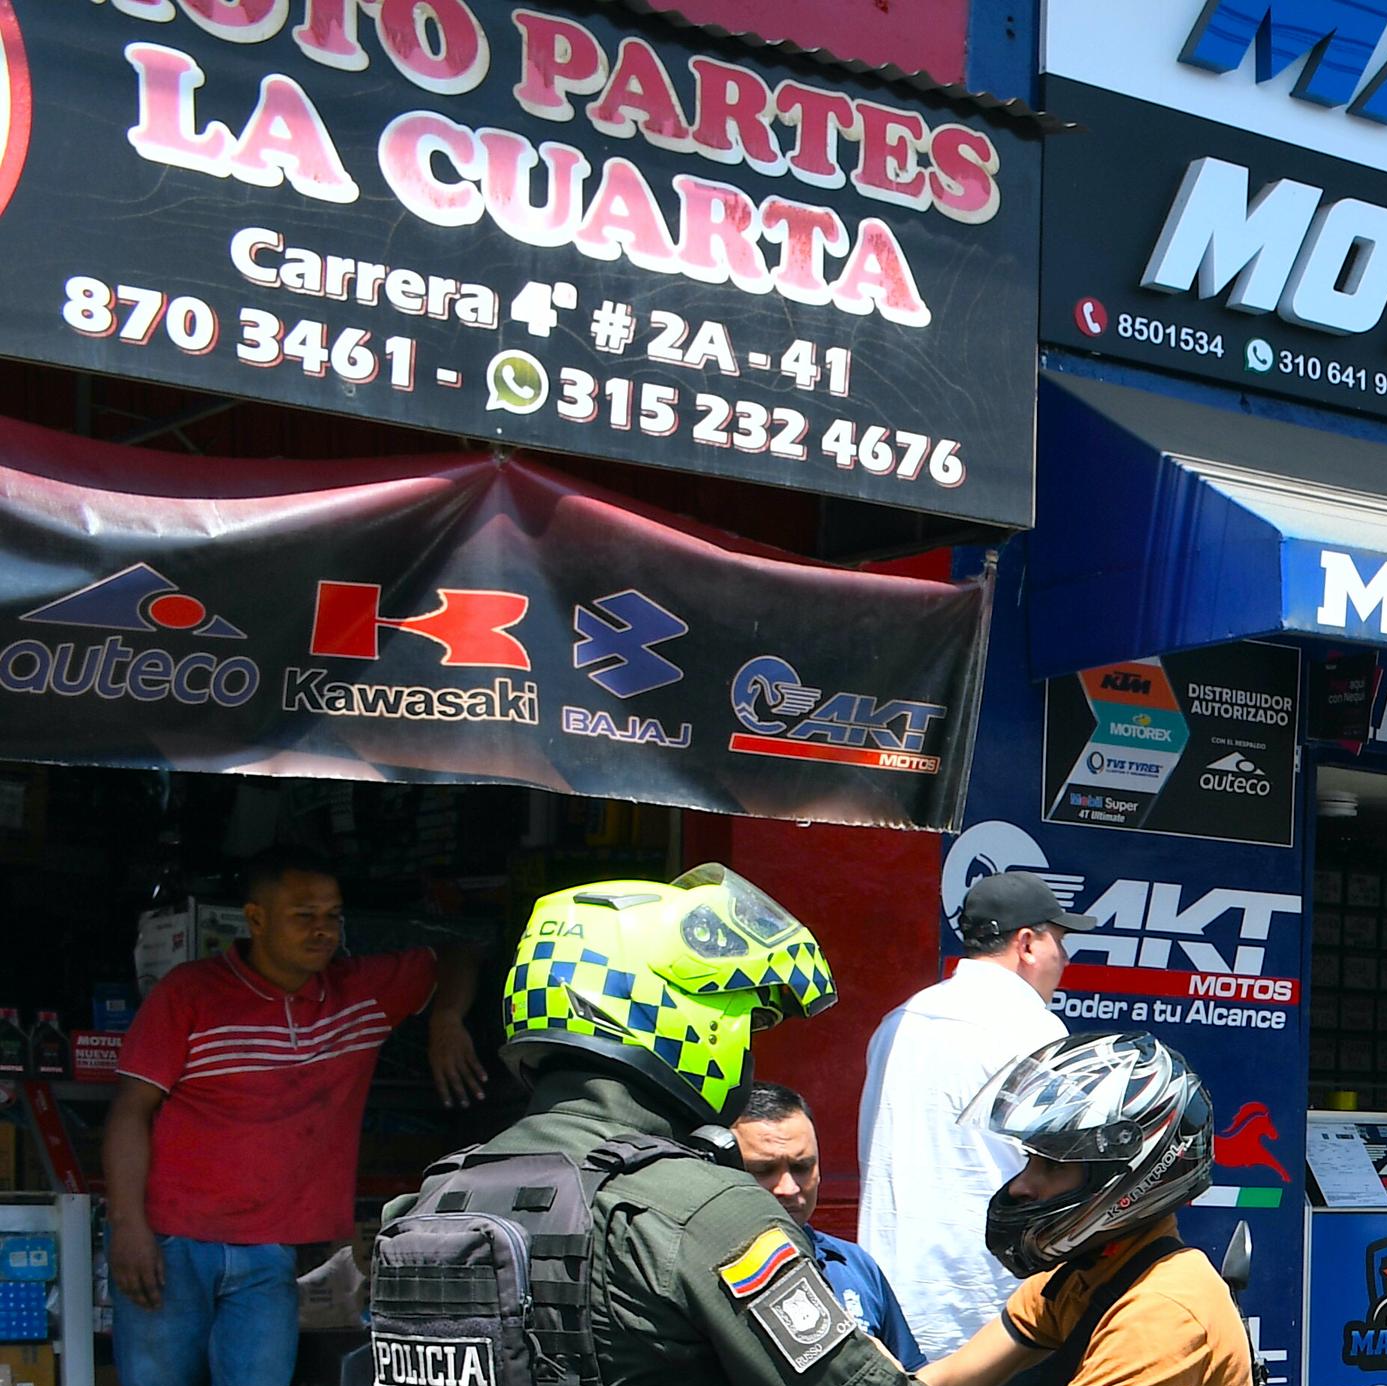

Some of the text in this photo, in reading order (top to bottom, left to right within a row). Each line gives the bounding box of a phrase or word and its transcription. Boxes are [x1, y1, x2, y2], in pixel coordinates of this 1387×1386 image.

[97, 0, 1001, 223] TO PARTES
[123, 43, 932, 327] LA CUARTA
[230, 227, 499, 330] Carrera
[592, 302, 635, 353] #
[1117, 313, 1224, 358] 8501534
[1279, 350, 1321, 380] 310
[1327, 361, 1366, 390] 641
[62, 275, 217, 354] 870
[236, 308, 415, 392] 3461
[558, 367, 679, 439] 315
[693, 394, 807, 459] 232
[822, 417, 966, 489] 4676
[0, 635, 259, 709] auteco
[1102, 671, 1151, 694] KTM
[282, 666, 541, 727] Kawasaki
[1188, 683, 1292, 711] DISTRIBUIDOR
[562, 705, 692, 748] BAJAJ
[785, 691, 947, 752] AKT
[1191, 700, 1288, 727] AUTORIZADO
[1110, 722, 1171, 742] MOTOREX
[1211, 737, 1226, 745] CON
[879, 754, 938, 772] MOTOS
[1106, 759, 1126, 770] TVS
[1128, 761, 1161, 773] TYRES
[1200, 773, 1270, 796] auteco
[1091, 811, 1125, 823] Ultimate
[1105, 798, 1138, 812] Super
[1065, 879, 1302, 976] AKT
[1188, 975, 1292, 1000] MOTOS
[1047, 991, 1286, 1029] Poder a tu Alcance
[76, 1035, 122, 1046] MOTUL
[76, 1050, 117, 1060] NUEVA
[796, 1343, 823, 1368] RUSSO
